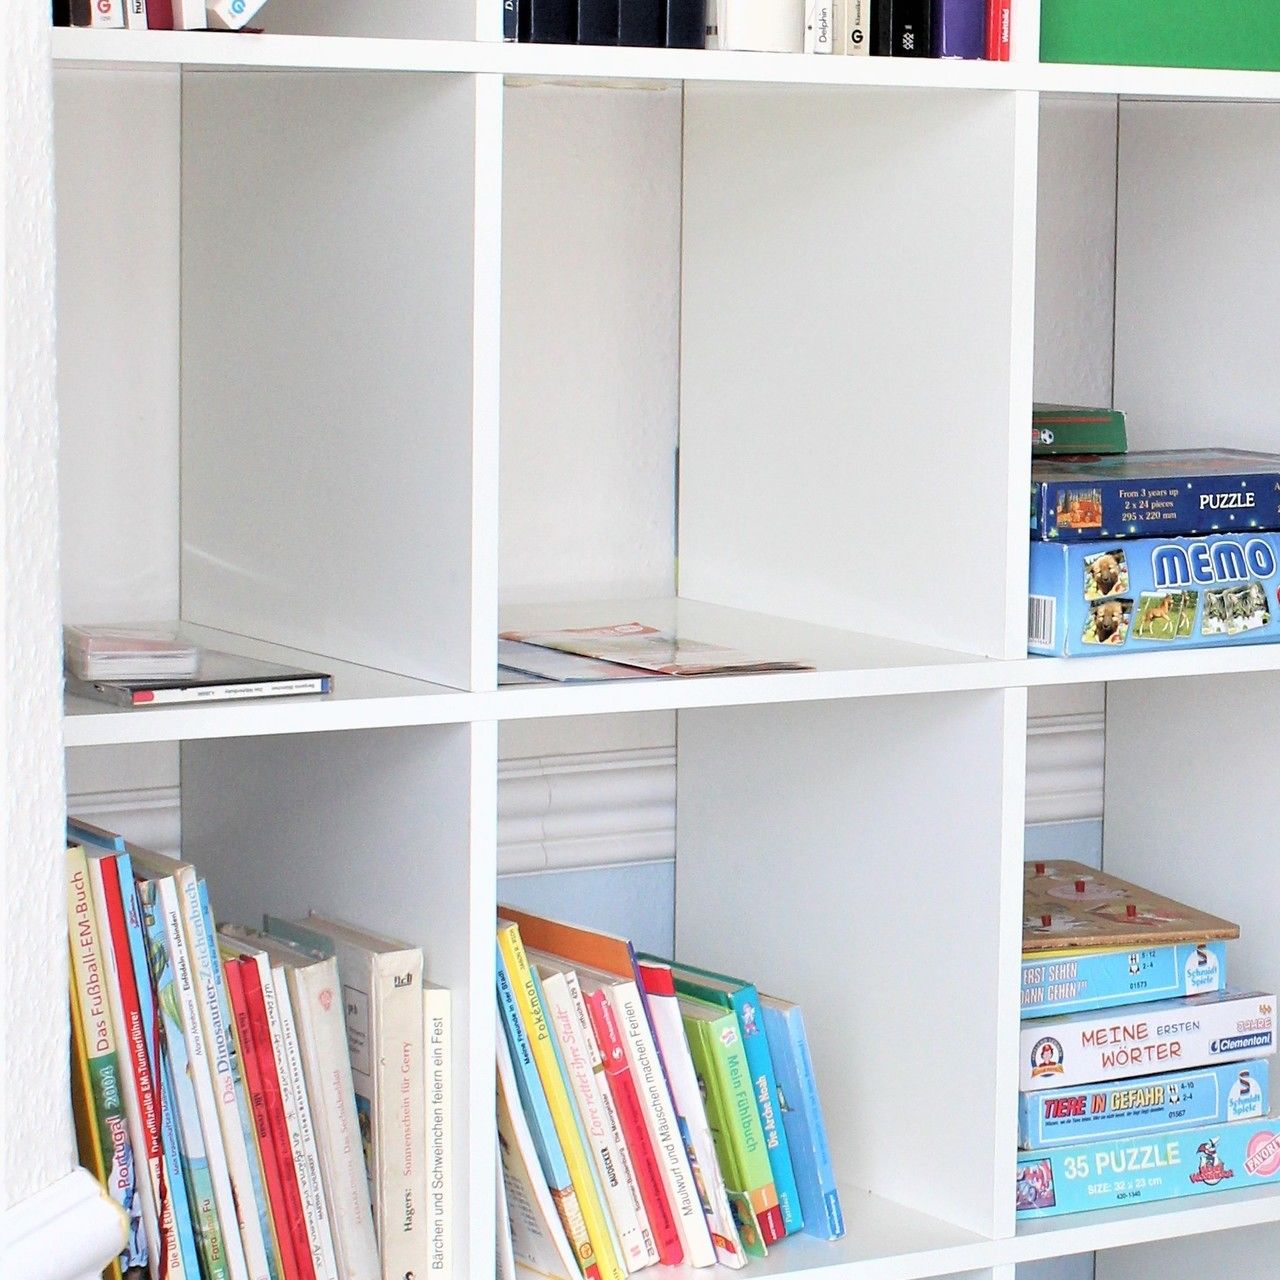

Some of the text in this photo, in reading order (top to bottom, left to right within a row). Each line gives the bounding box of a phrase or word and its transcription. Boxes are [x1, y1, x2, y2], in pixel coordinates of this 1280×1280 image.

[818, 8, 829, 43] Delphin
[1119, 488, 1179, 499] From 3 years up
[1125, 500, 1174, 510] 2 pieces
[1199, 492, 1255, 510] PUZZLE
[1121, 512, 1137, 521] 295
[1145, 511, 1161, 520] 220
[1153, 539, 1277, 588] MEMO
[71, 870, 110, 1052] Das Fußball-EM-Buch
[1023, 962, 1078, 985] ERST SEHEN
[1187, 966, 1217, 977] Schmidt
[185, 882, 236, 1104] Das Dinosaurier-Zeichenbuch
[1130, 981, 1148, 990] 01573
[1191, 976, 1214, 986] Spiele
[505, 990, 525, 1042] Freunde der
[523, 980, 548, 1040] Pokémon
[1081, 1020, 1200, 1049] MEINE ERSTEN
[1220, 1036, 1271, 1051] Clementoni
[130, 1010, 151, 1091] EM-Turnierführer
[1101, 1041, 1182, 1068] WÖRTER
[1181, 1082, 1195, 1090] 4-10
[1229, 1094, 1260, 1106] Schmidt
[622, 1001, 694, 1216] Maulwurf und Mäuschen machen Ferien
[727, 1054, 757, 1153] Mein Fühlbuch
[1044, 1096, 1086, 1119] TIERE
[1090, 1093, 1107, 1114] IN
[1111, 1086, 1165, 1112] GEFAHR
[1168, 1110, 1186, 1119] 01567
[99, 1066, 131, 1189] Portugal 2004
[399, 1041, 415, 1232] Hagers: Sonnenschein Gerry
[761, 1102, 780, 1149] Die Arche
[430, 1016, 445, 1270] Bärchen und Schweinchen feiern ein Fest
[171, 1157, 180, 1176] Mein
[600, 1147, 619, 1188] GAUDECKER
[1064, 1155, 1089, 1180] 35
[1095, 1142, 1181, 1176] PUZZLE
[1148, 1177, 1162, 1187] cm
[202, 1199, 212, 1213] Fu
